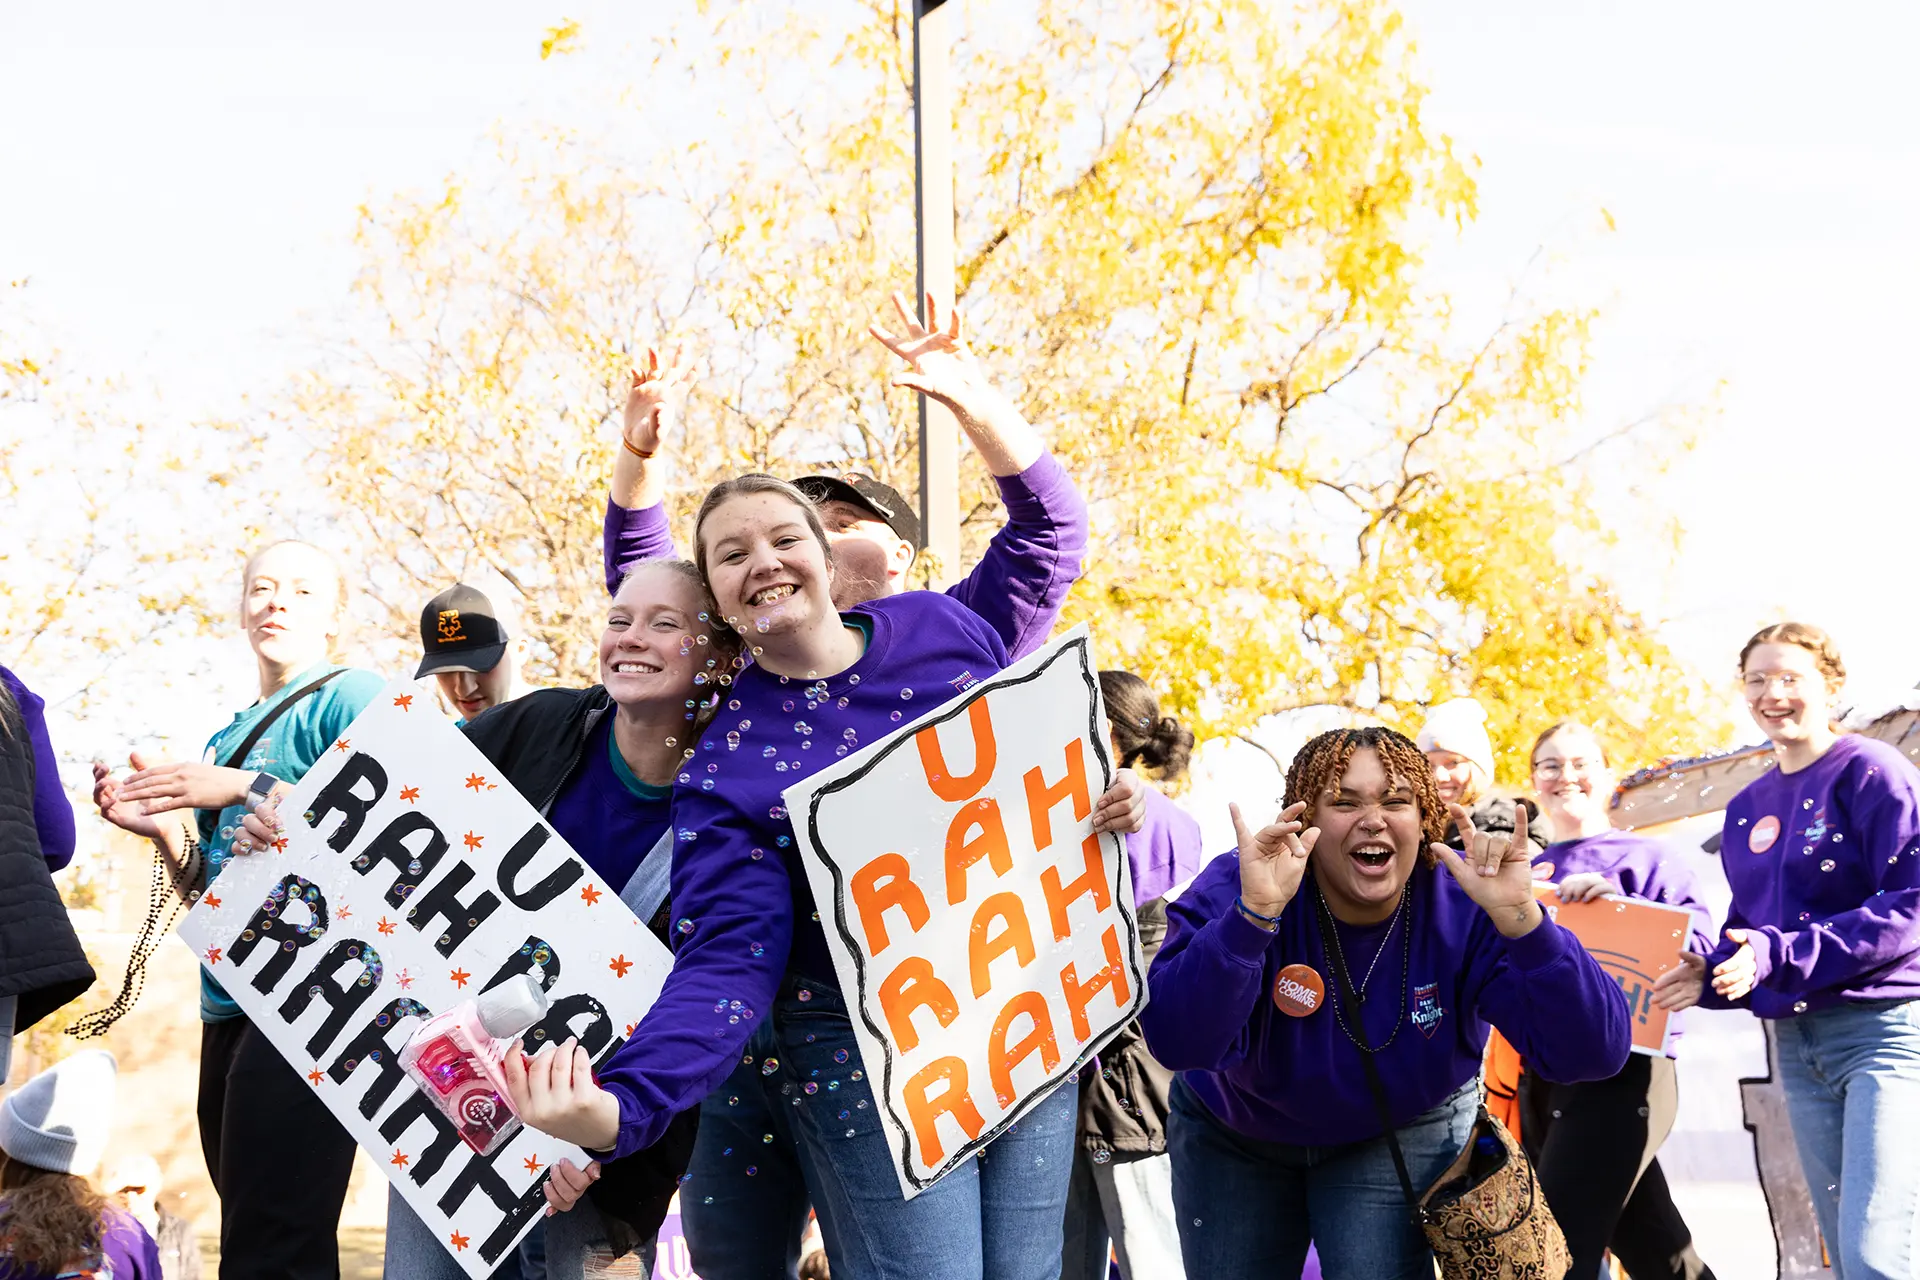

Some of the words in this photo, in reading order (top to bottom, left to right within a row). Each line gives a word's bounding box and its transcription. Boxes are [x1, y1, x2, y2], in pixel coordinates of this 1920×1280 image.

[916, 695, 997, 802] U
[497, 822, 585, 912] U
[851, 738, 1092, 957] RAH
[310, 752, 501, 959] RAH
[477, 934, 627, 1066] RA
[878, 833, 1111, 1056] RAH
[1278, 976, 1318, 999] HOME
[1278, 986, 1317, 1009] COMING
[1411, 1007, 1444, 1025] Knight
[902, 924, 1130, 1169] RAH
